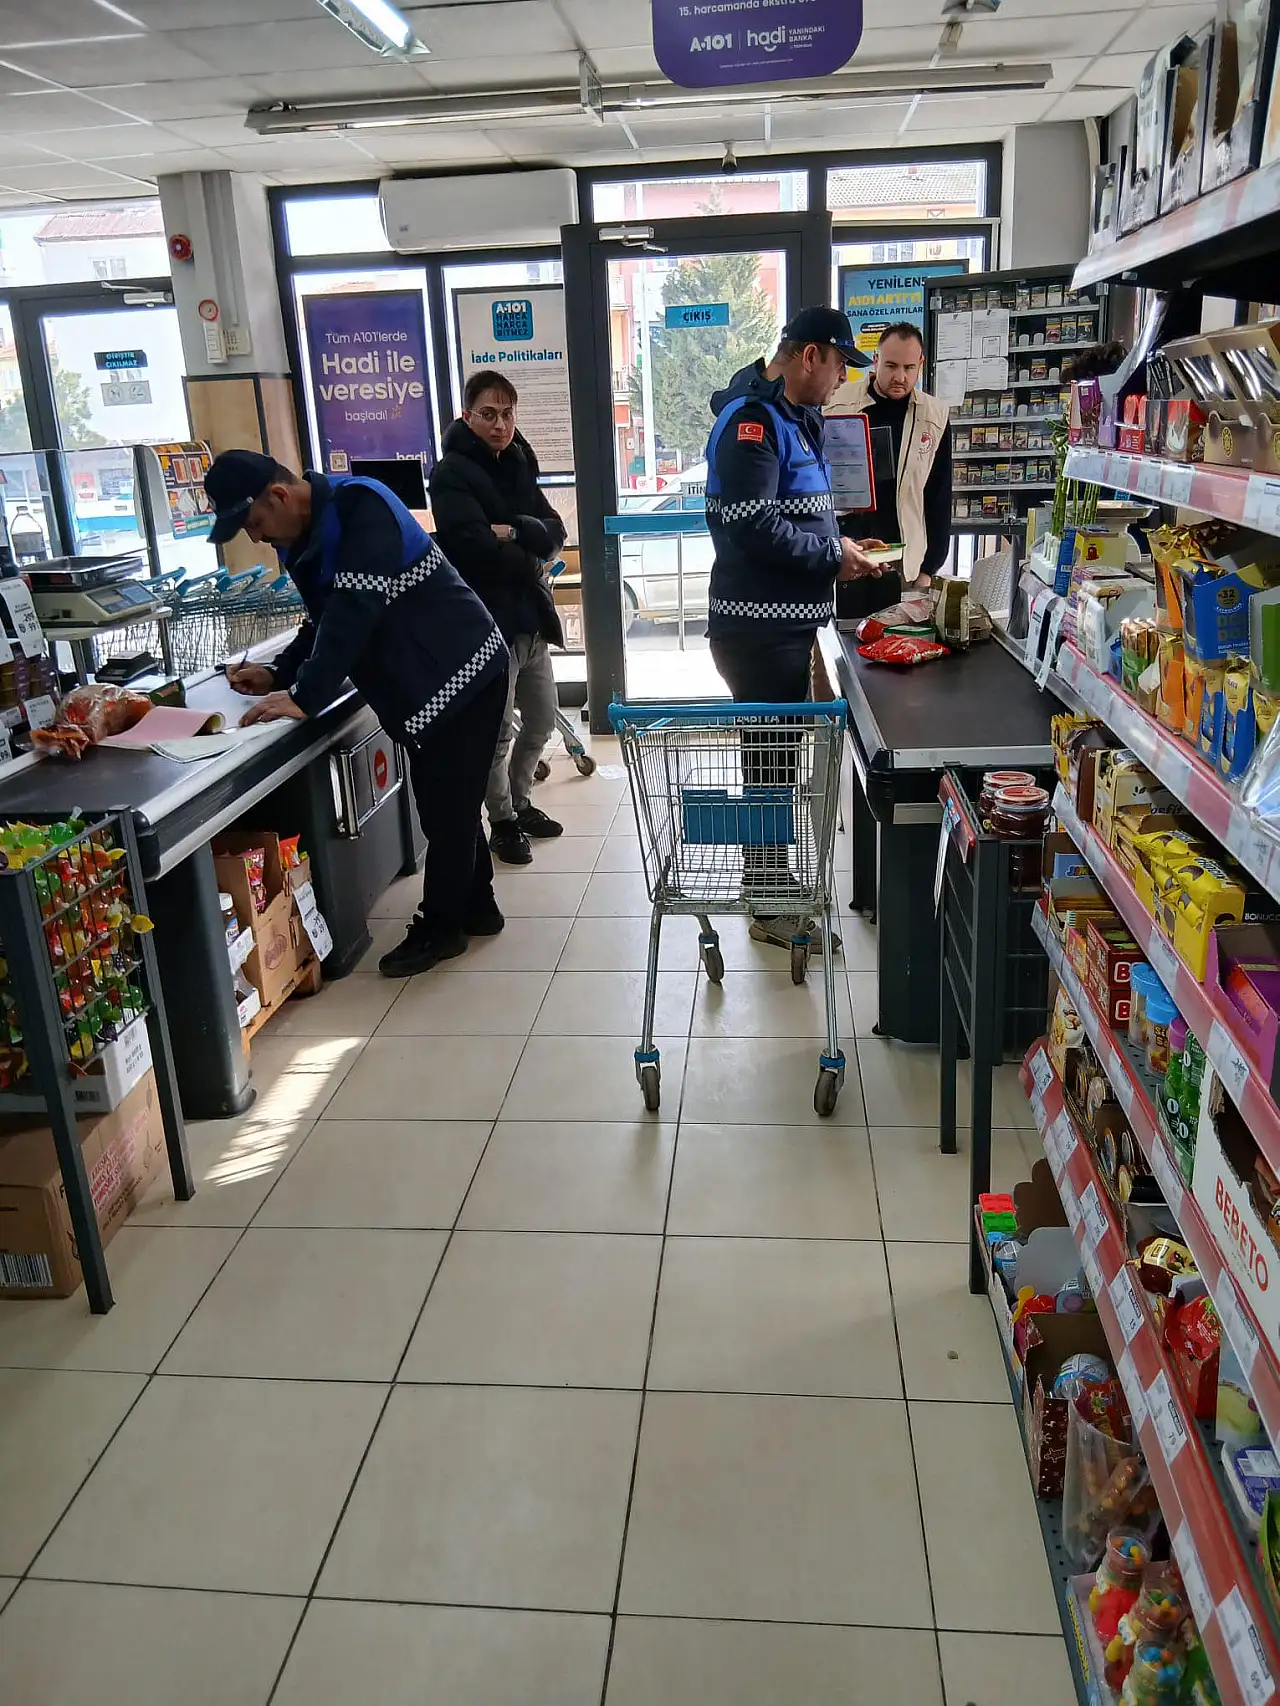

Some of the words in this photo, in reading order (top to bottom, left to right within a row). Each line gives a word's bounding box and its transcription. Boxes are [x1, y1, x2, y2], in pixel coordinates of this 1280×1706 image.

[678, 7, 692, 16] 15.
[694, 1, 760, 15] harcamanda
[747, 26, 786, 47] hadi
[496, 312, 527, 321] HARCA
[683, 310, 712, 323] ÇIKIŞ
[869, 307, 889, 316] ÖZEL
[496, 320, 528, 329] HARCA
[325, 331, 350, 345] Tüm
[353, 330, 408, 344] A101'lerde
[321, 350, 380, 375] Hadi
[387, 349, 416, 374] ile
[471, 350, 497, 364] İade
[498, 349, 563, 363] Politikaları
[319, 377, 425, 405] veresiye
[1215, 1176, 1269, 1292] BEBETO
